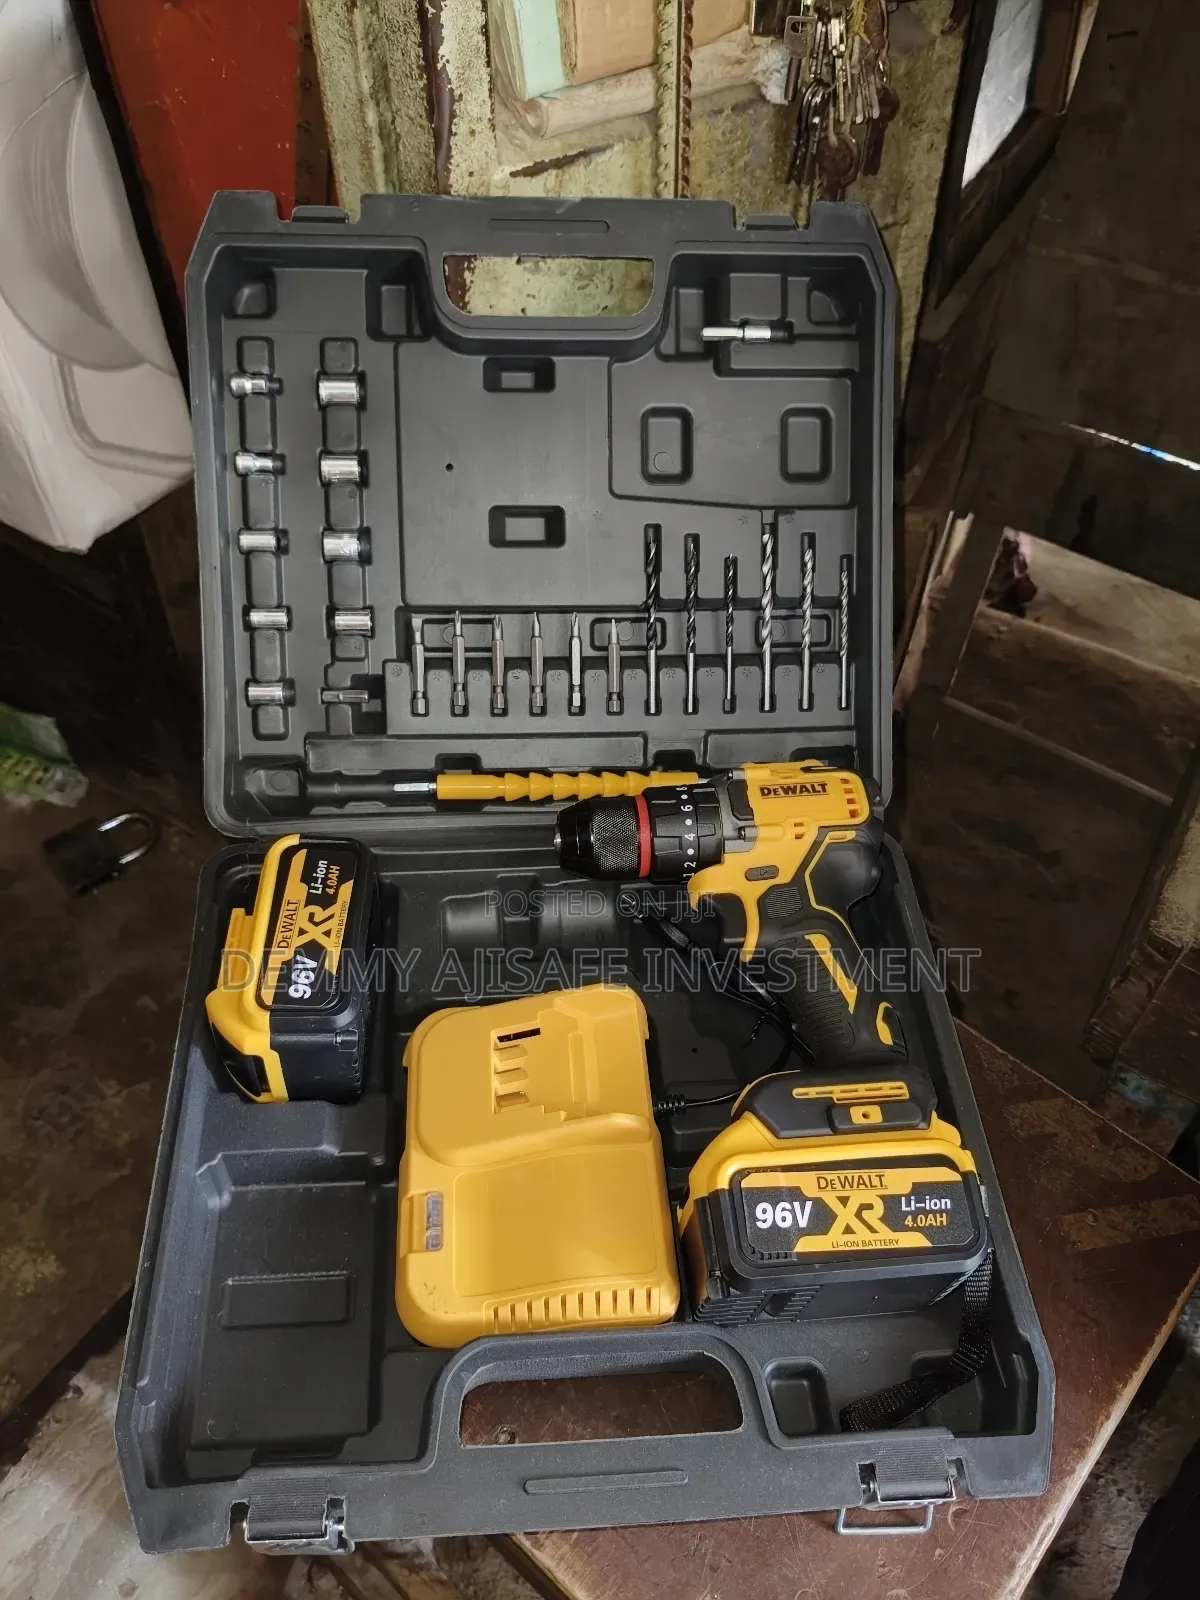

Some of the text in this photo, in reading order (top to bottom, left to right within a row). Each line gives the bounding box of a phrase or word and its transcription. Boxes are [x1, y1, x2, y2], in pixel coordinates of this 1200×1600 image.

[759, 782, 828, 798] DEWALT
[684, 833, 696, 841] 4
[310, 860, 328, 894] Li-ion
[325, 865, 340, 895] 4.0AH
[277, 900, 299, 948] DEWALT
[295, 904, 338, 948] XR
[338, 900, 349, 927] BATTERY
[288, 954, 318, 999] 96V
[816, 1174, 886, 1190] DEWALT
[755, 1201, 813, 1229] 96V
[822, 1195, 893, 1236] XR
[902, 1196, 951, 1211] Li-ion
[904, 1213, 947, 1227] 4.0AH
[832, 1239, 899, 1248] LI-ION BATTERY
